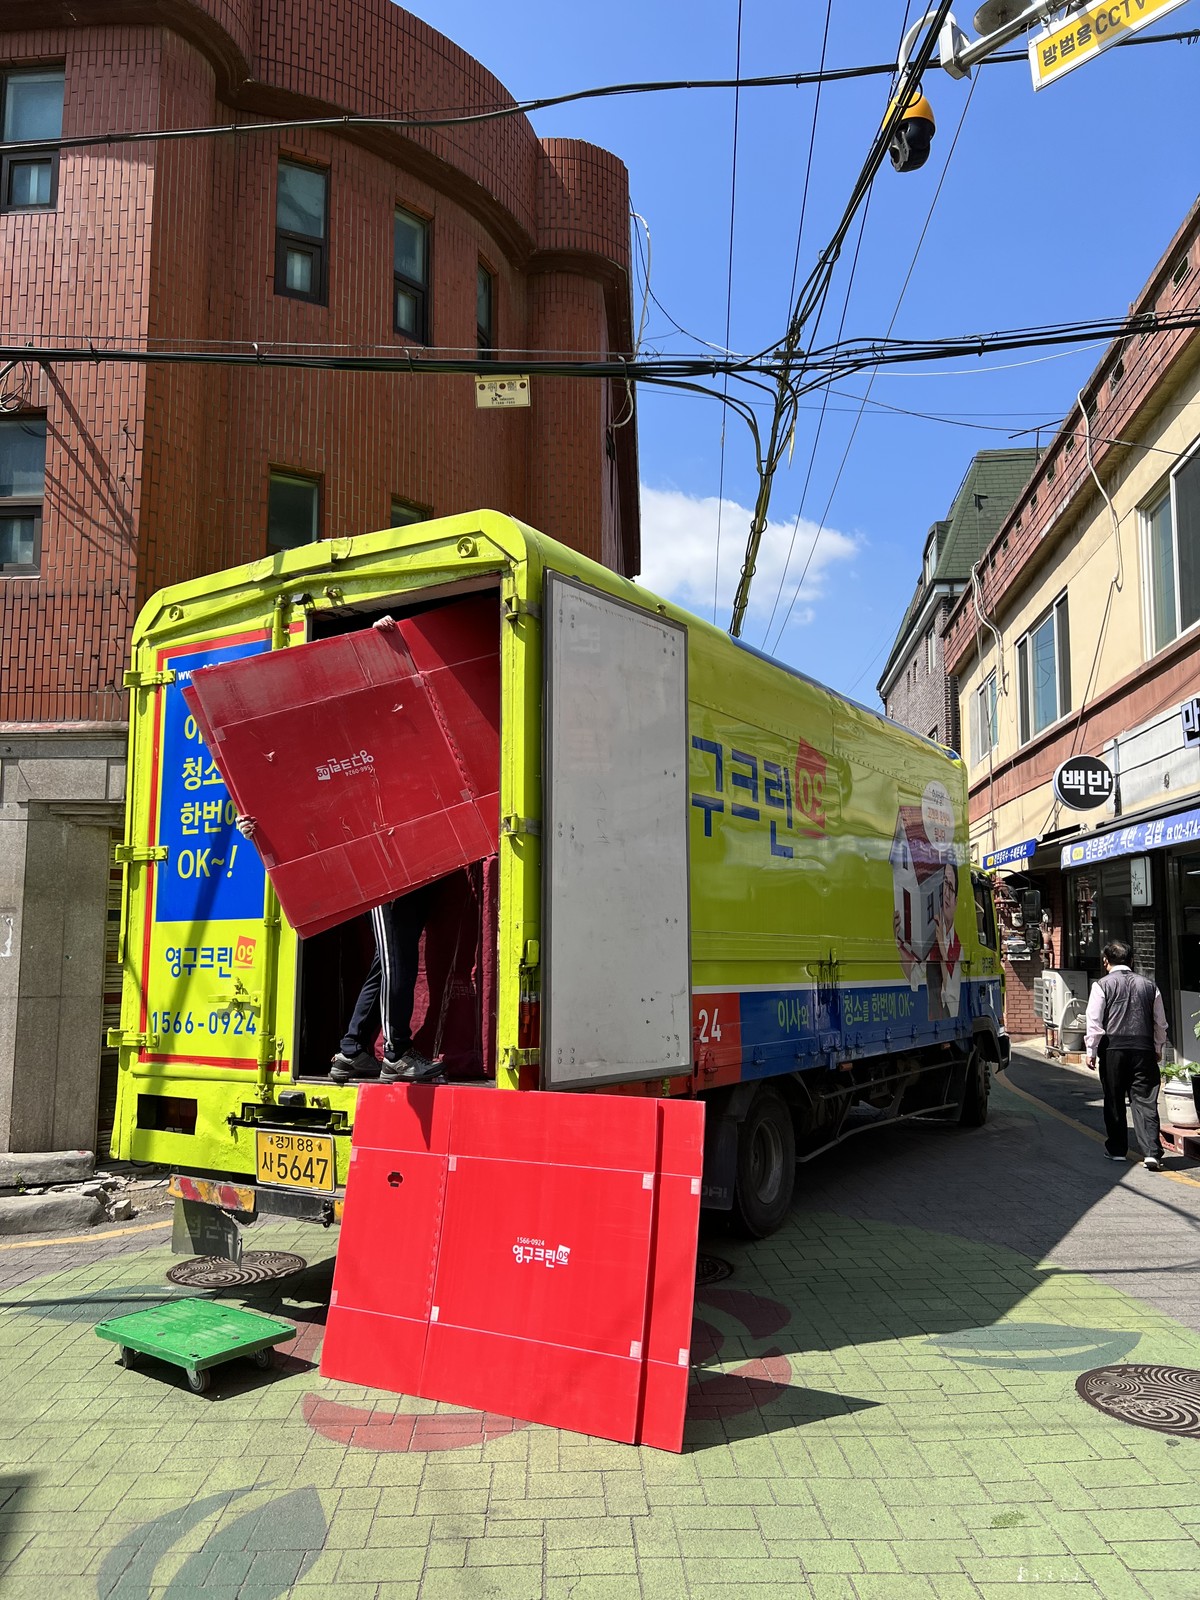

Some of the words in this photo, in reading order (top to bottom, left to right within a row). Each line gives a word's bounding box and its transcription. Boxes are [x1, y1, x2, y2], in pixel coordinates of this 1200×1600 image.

[1062, 770, 1112, 796] 백반
[1145, 820, 1164, 846] 김밥
[165, 947, 233, 978] 영구크린
[152, 1011, 256, 1035] 1566-0924
[777, 998, 809, 1033] 이사와
[844, 995, 870, 1026] 청소를
[871, 992, 897, 1022] 한번에
[516, 1236, 545, 1247] 1566-0924
[512, 1244, 556, 1269] 영구크린
